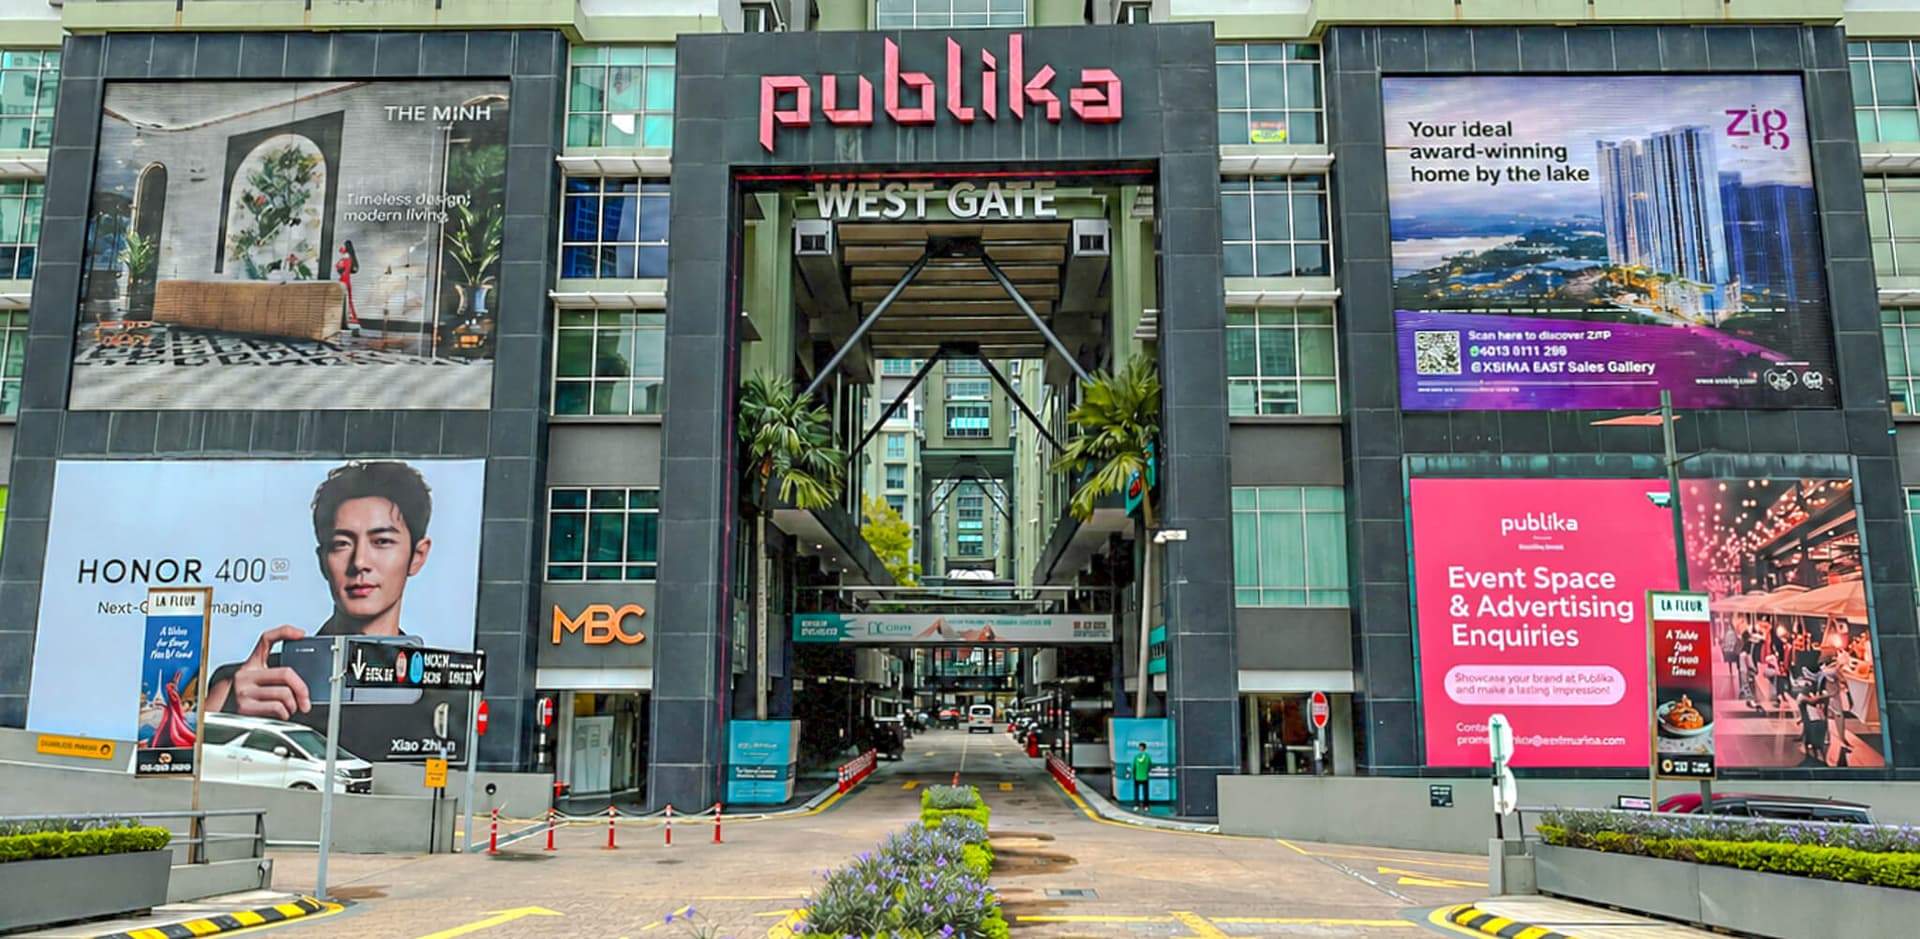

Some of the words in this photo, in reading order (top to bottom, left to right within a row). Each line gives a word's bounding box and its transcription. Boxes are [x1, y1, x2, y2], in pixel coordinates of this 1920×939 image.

[759, 33, 1122, 153] publika
[384, 106, 426, 121] THE
[432, 106, 491, 121] MINH
[1408, 121, 1456, 137] Your
[1463, 121, 1512, 137] ideal
[1410, 143, 1567, 162] award-winning
[1411, 166, 1470, 182] home
[1476, 165, 1500, 186] by
[1507, 165, 1541, 181] the
[1547, 165, 1589, 181] lake
[347, 193, 411, 206] Timeless
[815, 182, 935, 219] WEST
[947, 181, 1057, 219] GATE
[343, 209, 402, 222] modern
[1468, 330, 1496, 341] Scan
[1498, 331, 1523, 340] here
[1525, 331, 1536, 340] to
[1539, 331, 1584, 340] discover
[1533, 361, 1566, 372] EAST
[1568, 361, 1604, 373] Sales
[1608, 361, 1655, 375] Gallery
[1501, 512, 1578, 536] publika
[78, 559, 202, 584] HONOR
[215, 558, 266, 583] 400
[1448, 566, 1527, 589] Event
[1533, 566, 1616, 595] Space
[156, 595, 166, 606] LA
[1449, 594, 1470, 618] &
[1476, 594, 1635, 623] Advertising
[1661, 600, 1672, 611] LA
[1675, 600, 1703, 612] FLEUR
[552, 604, 646, 644] MBC
[1452, 623, 1580, 652] Enquiries
[1455, 672, 1504, 683] Showcase
[1508, 674, 1530, 684] your
[1532, 672, 1562, 683] brand
[1565, 674, 1576, 683] at
[1578, 672, 1614, 683] Publika
[1456, 685, 1475, 694] and
[1477, 685, 1505, 694] make
[1517, 685, 1550, 697] lasting
[1553, 685, 1610, 697] impression!
[391, 739, 419, 751] Xiao
[421, 738, 456, 752] Zhn
